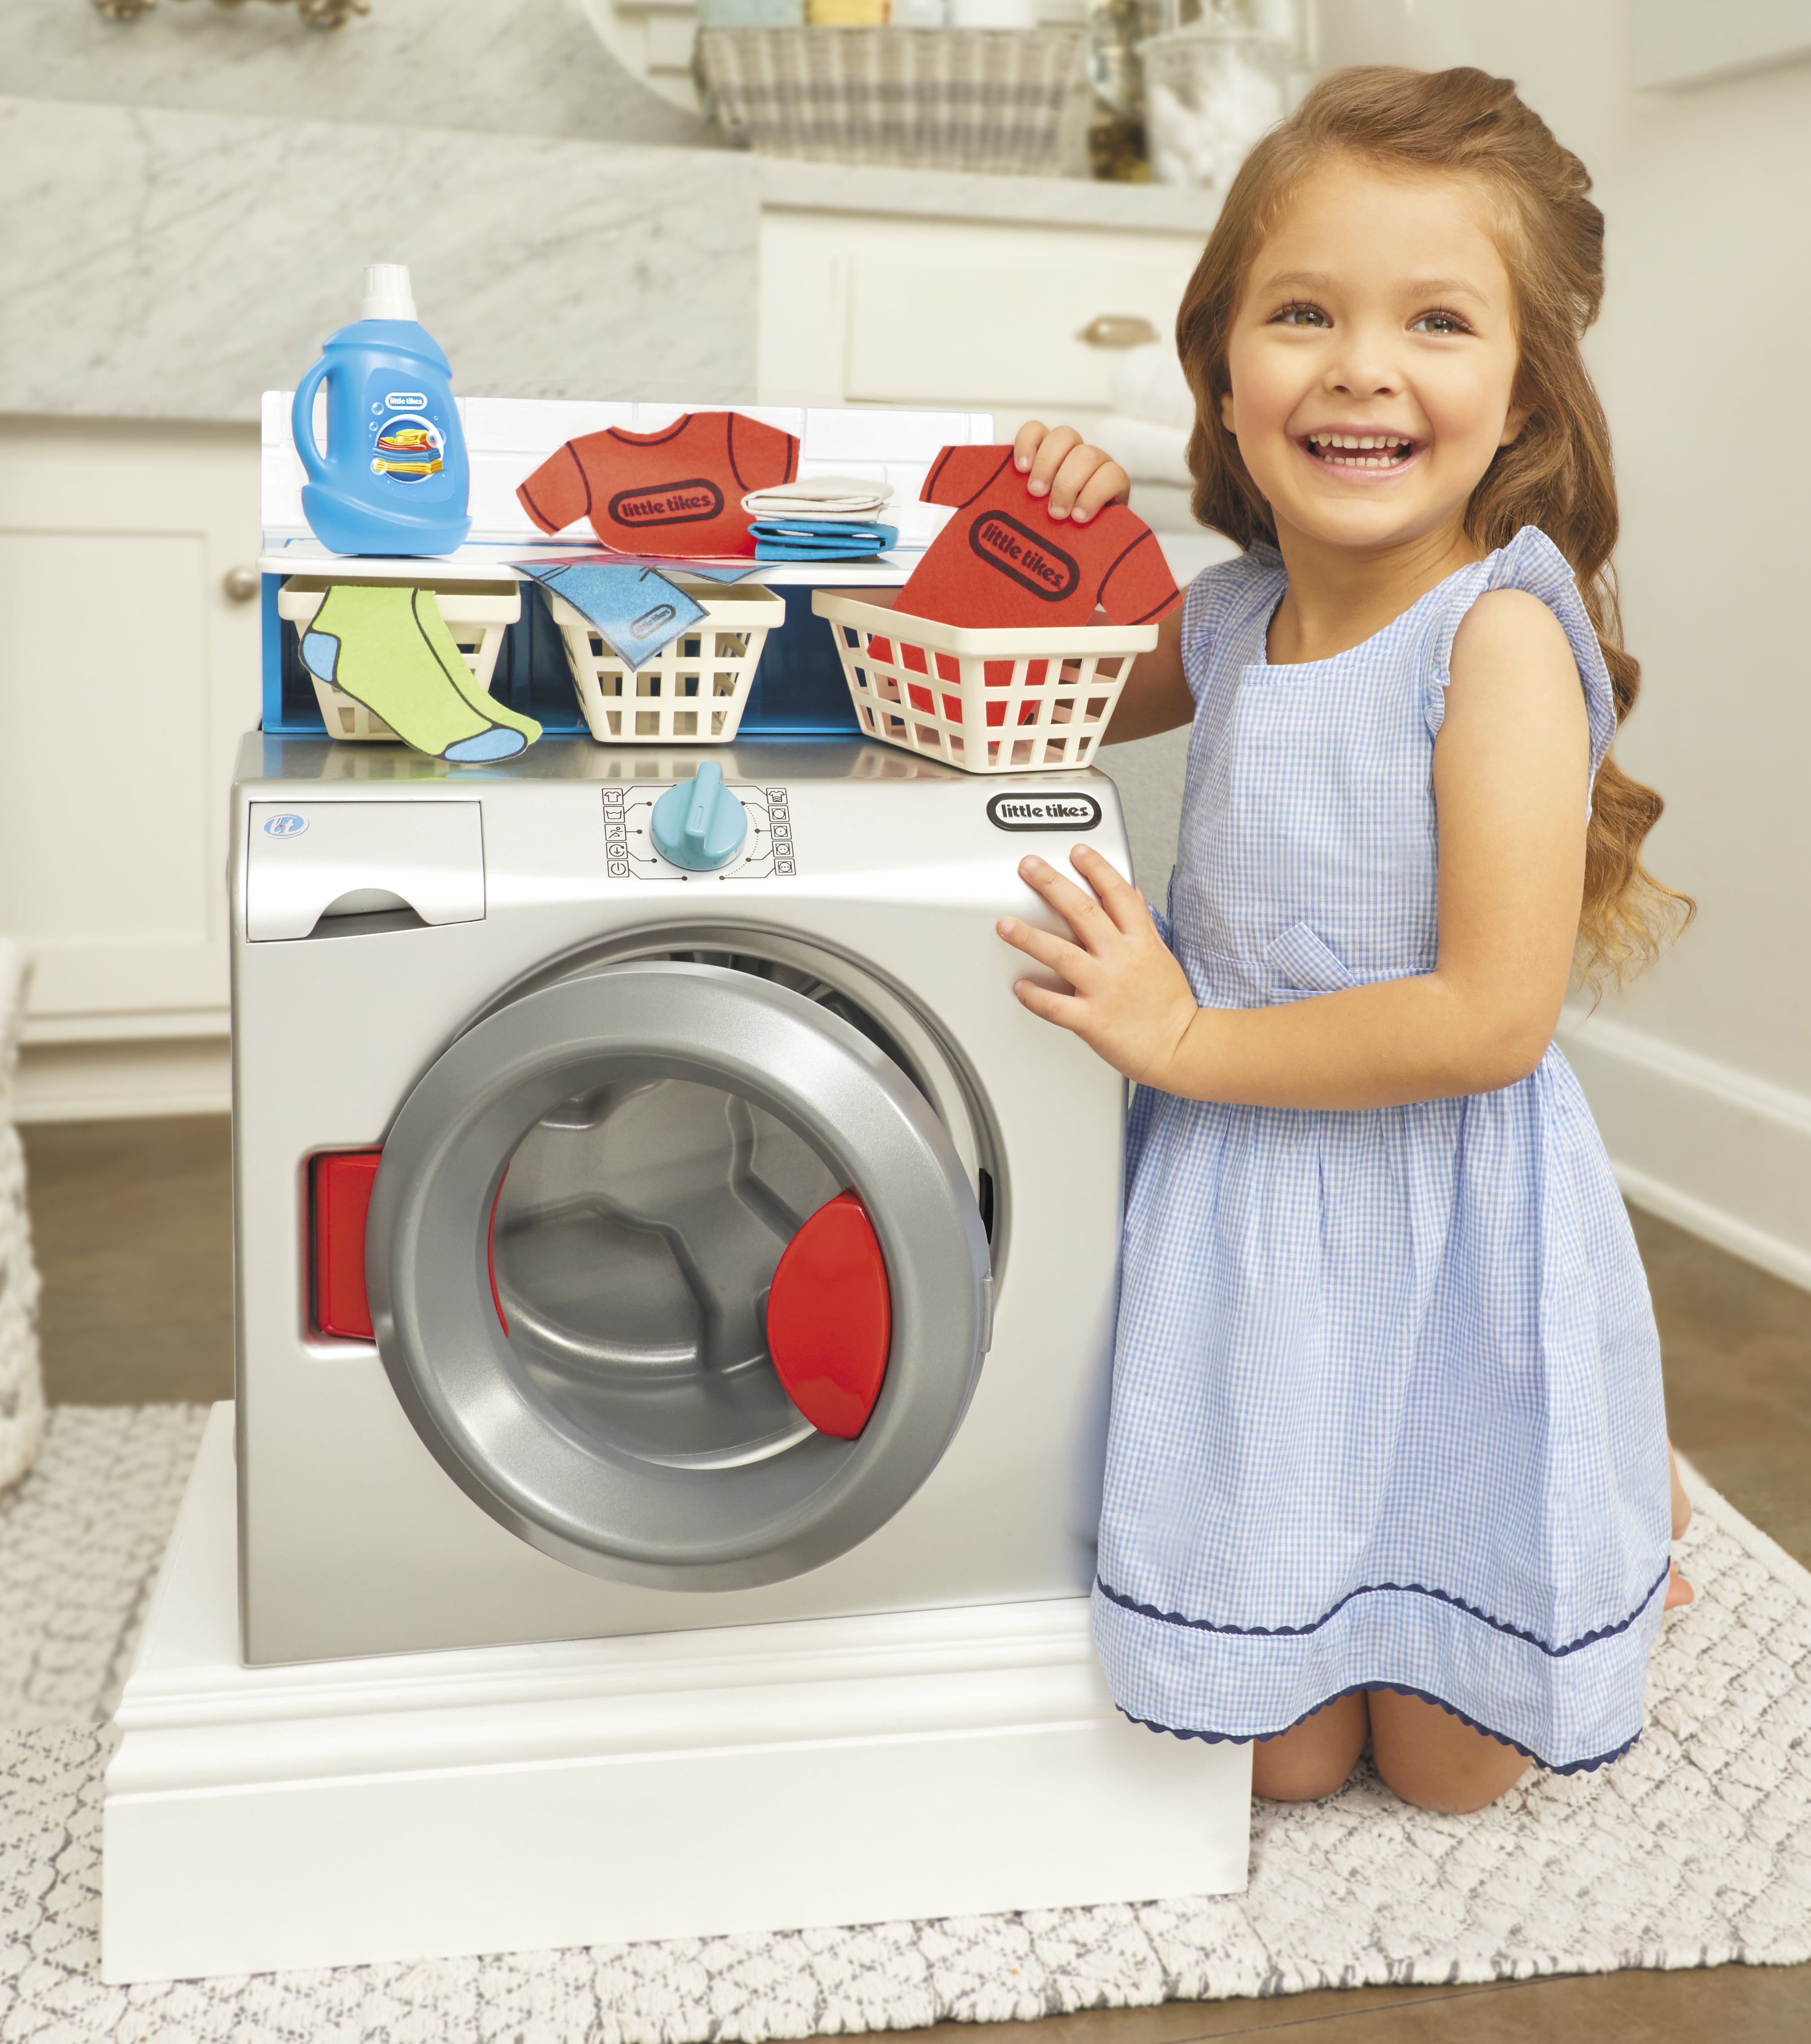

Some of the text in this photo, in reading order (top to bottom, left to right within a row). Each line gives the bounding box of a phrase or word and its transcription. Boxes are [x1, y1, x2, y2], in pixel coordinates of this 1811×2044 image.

[622, 495, 711, 517] little tikes
[982, 523, 1064, 587] little tikes
[1001, 804, 1088, 818] little tikes
